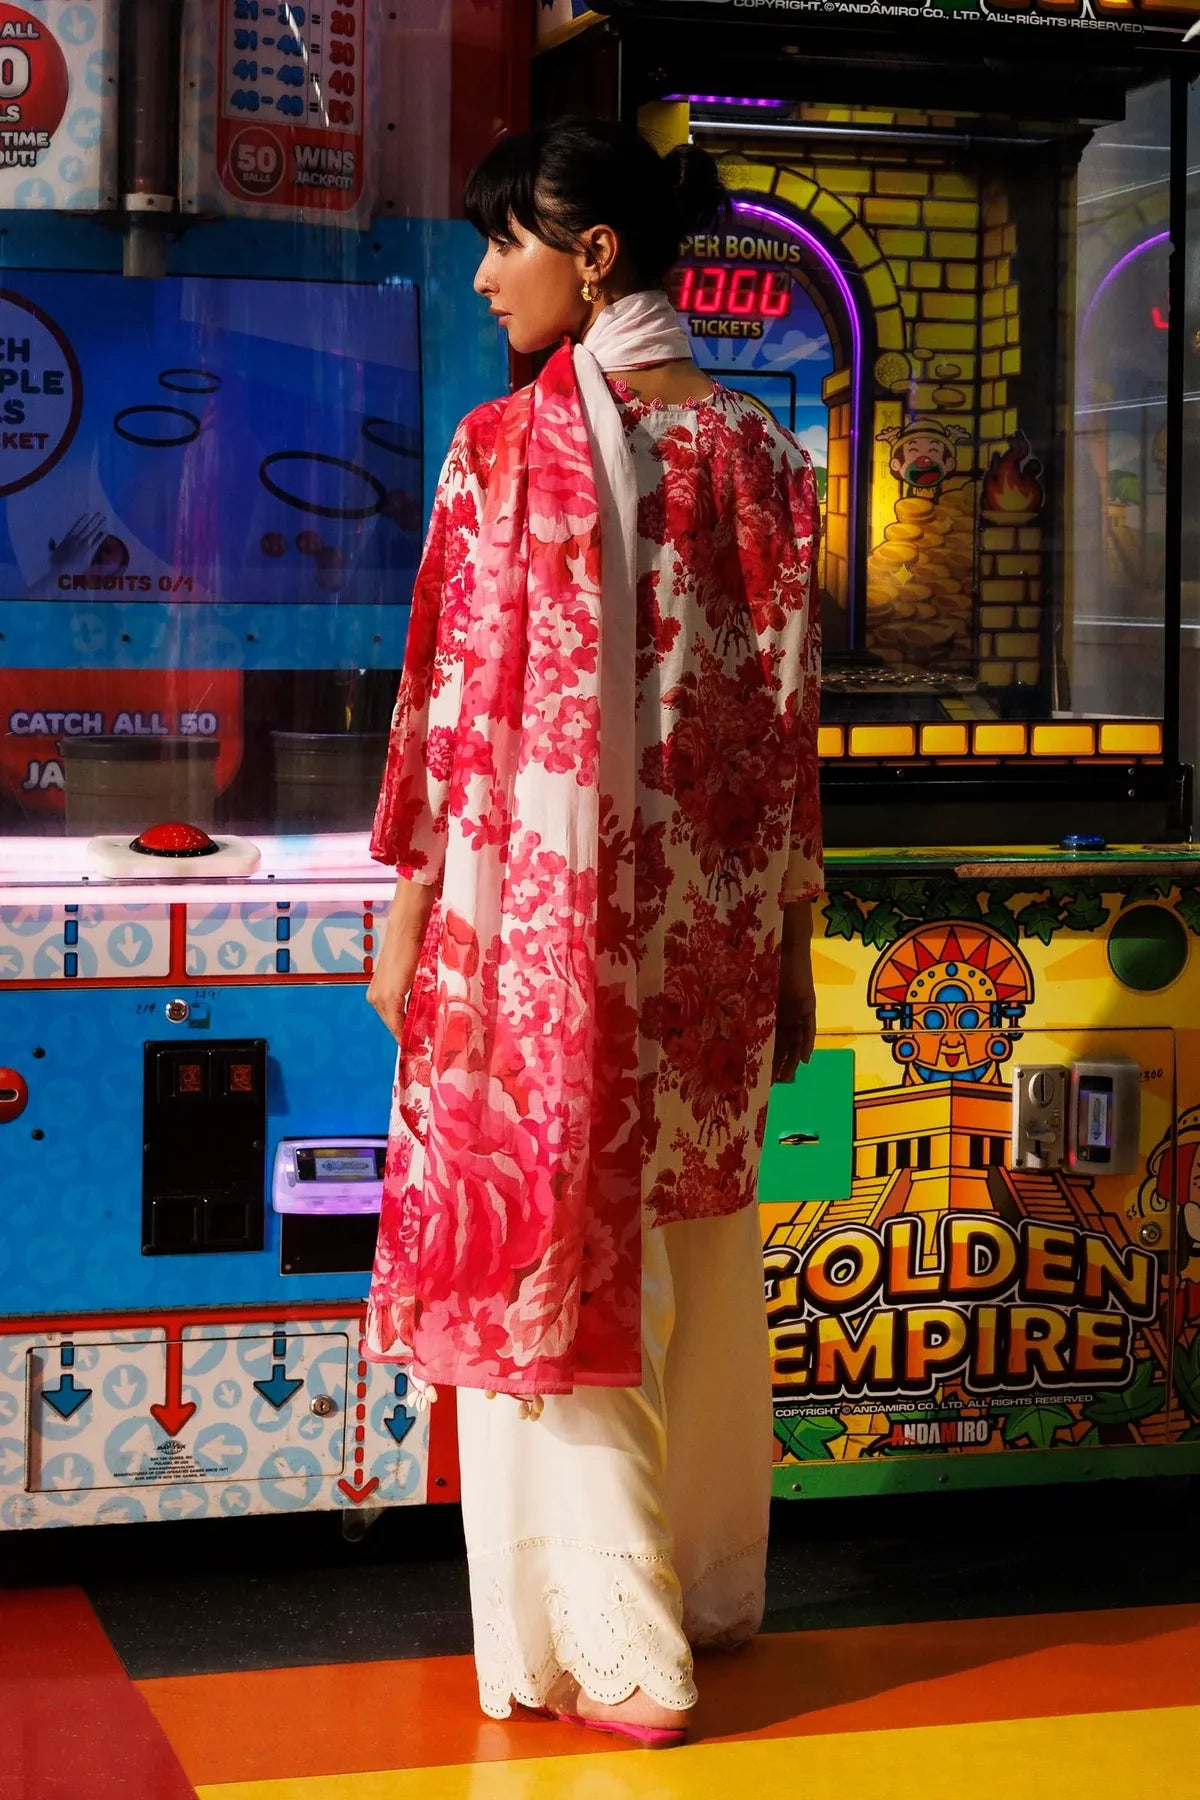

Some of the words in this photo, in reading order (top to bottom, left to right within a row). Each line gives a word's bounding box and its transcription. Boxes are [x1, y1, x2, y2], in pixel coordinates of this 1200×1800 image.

[838, 3, 919, 17] ANDAMIRO
[1016, 14, 1067, 27] RIGHTS
[1, 22, 39, 39] ALL
[1, 131, 49, 147] TIME
[238, 144, 277, 174] 50
[294, 144, 355, 175] WINS
[243, 173, 272, 183] BALLS
[725, 234, 801, 263] BONUS
[690, 318, 762, 338] TICKETS
[57, 573, 152, 592] CREDITS
[10, 711, 103, 735] CATCH
[113, 712, 168, 735] ALL
[179, 712, 217, 735] 50
[762, 1217, 1154, 1316] GOLDEN
[767, 1305, 1126, 1388] EMPIRE
[775, 1406, 840, 1418] COPYRIGHT
[853, 1402, 915, 1414] ANDAMIRO
[941, 1400, 965, 1410] LTD.
[967, 1399, 989, 1409] ALL
[991, 1397, 1032, 1407] RIGHTS
[886, 1419, 988, 1447] ANDAMIRO
